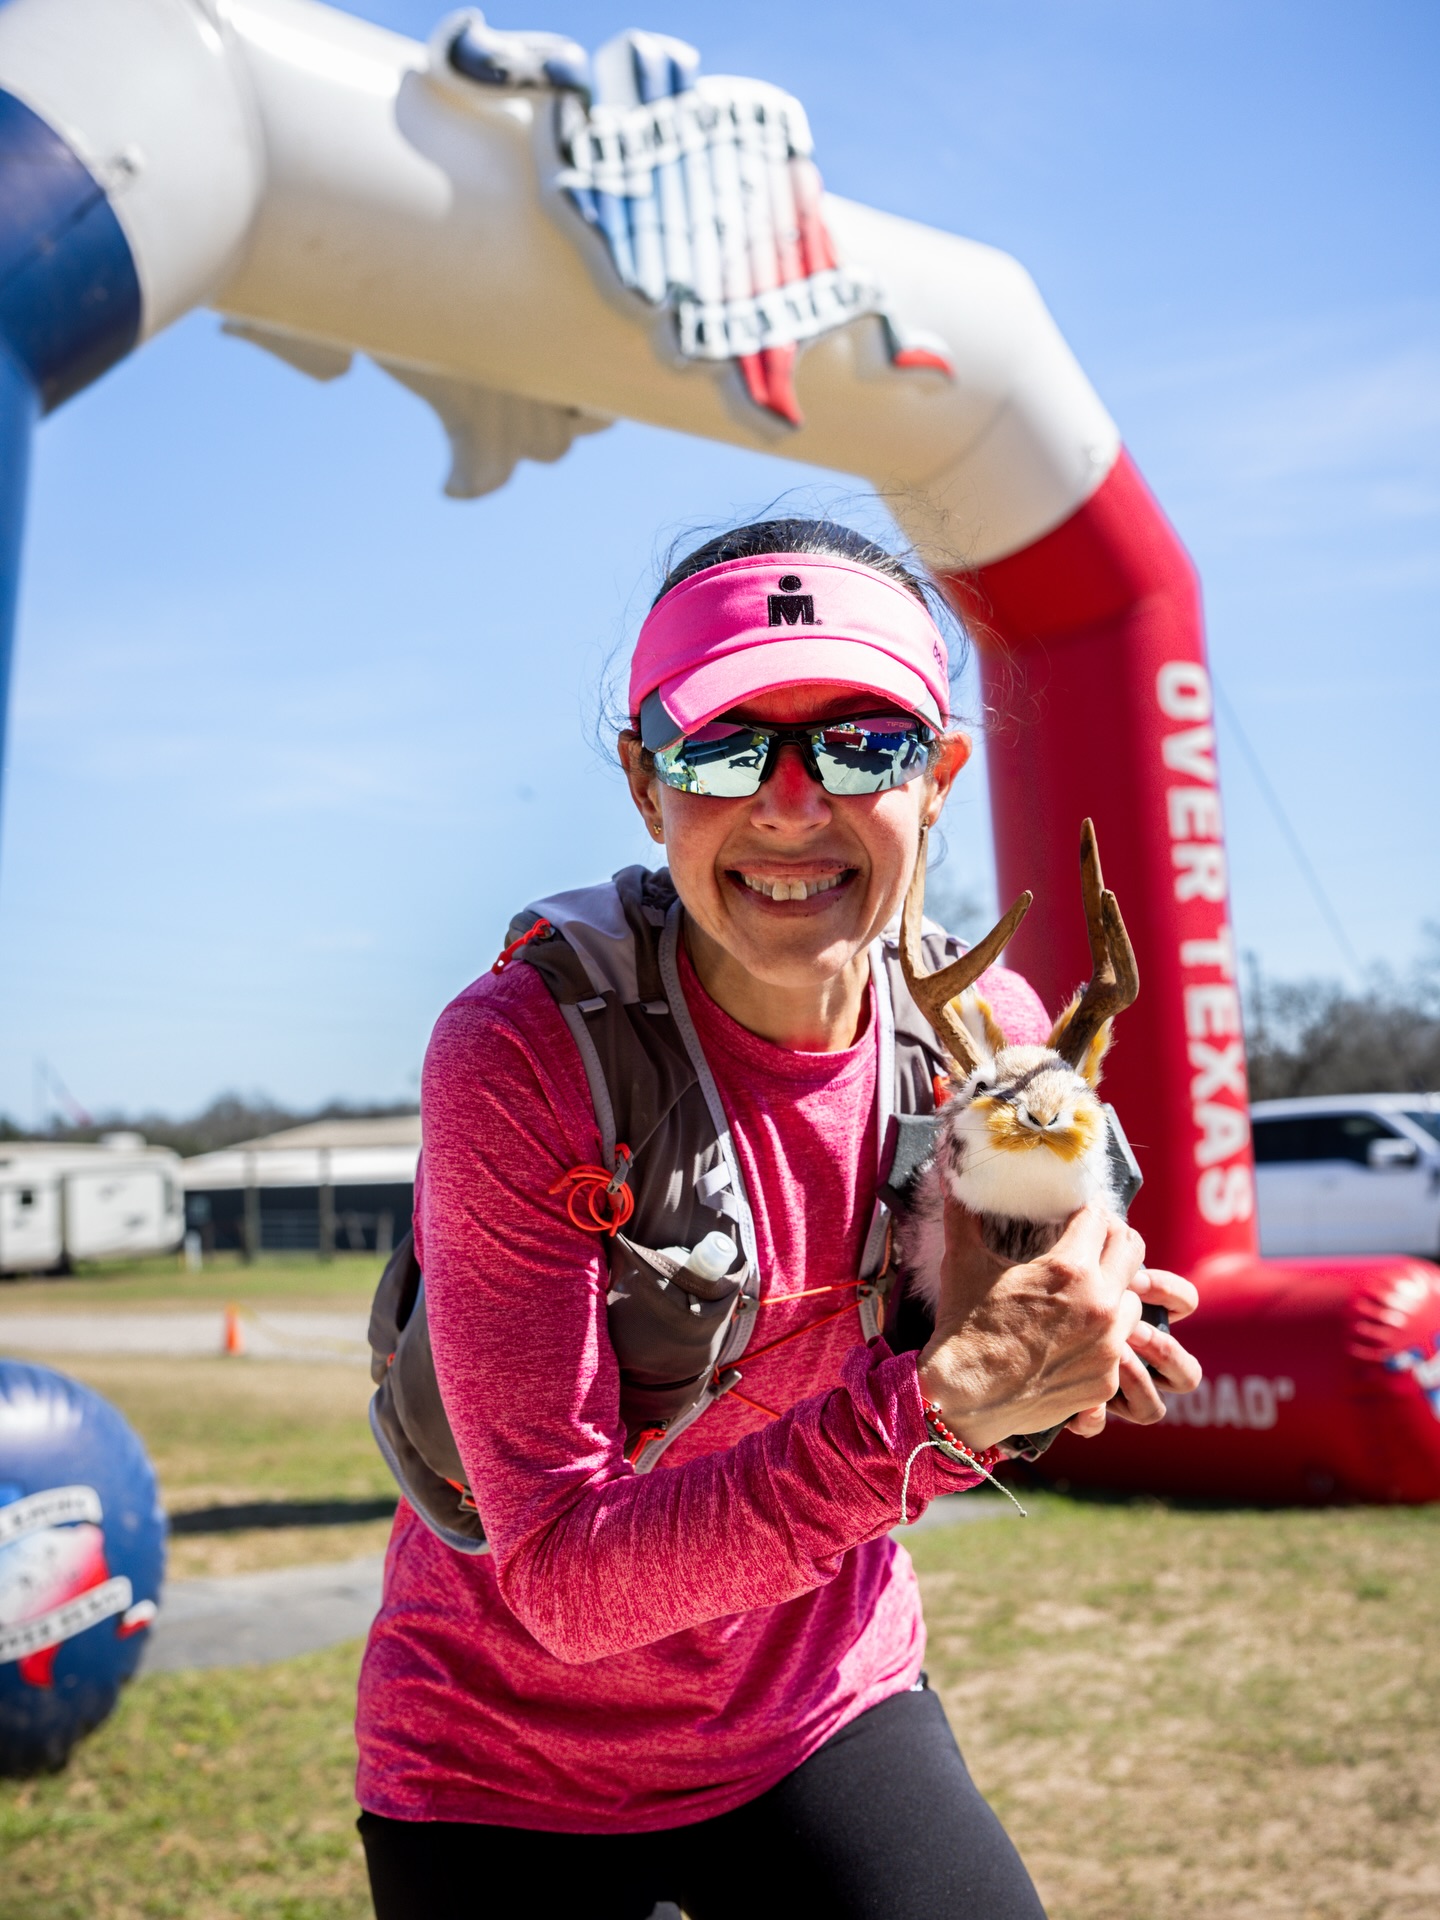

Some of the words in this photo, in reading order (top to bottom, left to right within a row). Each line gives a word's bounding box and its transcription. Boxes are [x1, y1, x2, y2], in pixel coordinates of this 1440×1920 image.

[886, 721, 913, 729] TIFOSI
[1156, 660, 1230, 902] OVER
[1180, 926, 1251, 1226] TEXAS
